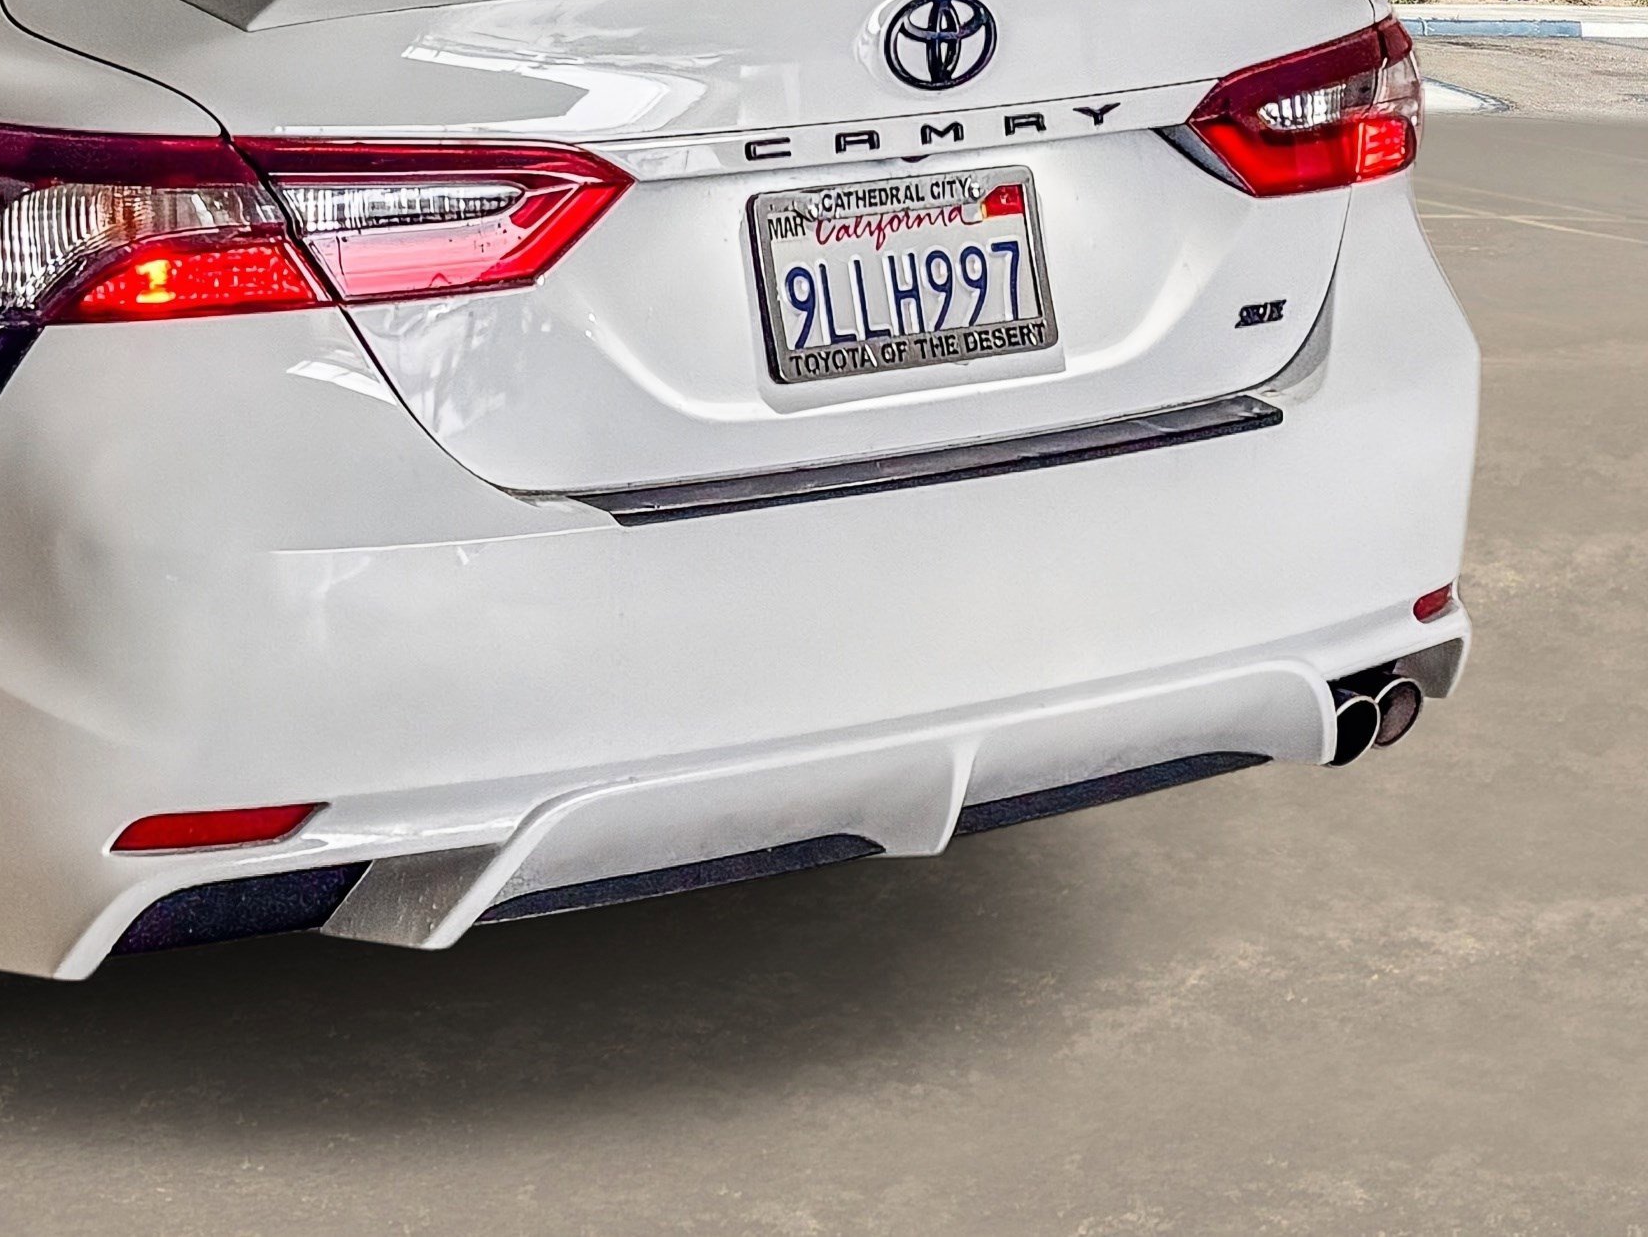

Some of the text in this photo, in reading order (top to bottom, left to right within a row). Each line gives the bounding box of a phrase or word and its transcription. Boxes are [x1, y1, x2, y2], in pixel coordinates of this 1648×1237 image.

[744, 102, 1121, 162] CAMRY
[821, 177, 969, 212] CATHEDRAL CITY
[767, 215, 807, 241] MAR
[815, 204, 984, 252] California
[783, 240, 1021, 350] 9LLH997
[789, 322, 1047, 376] TOYOTA OF THE DESERT
